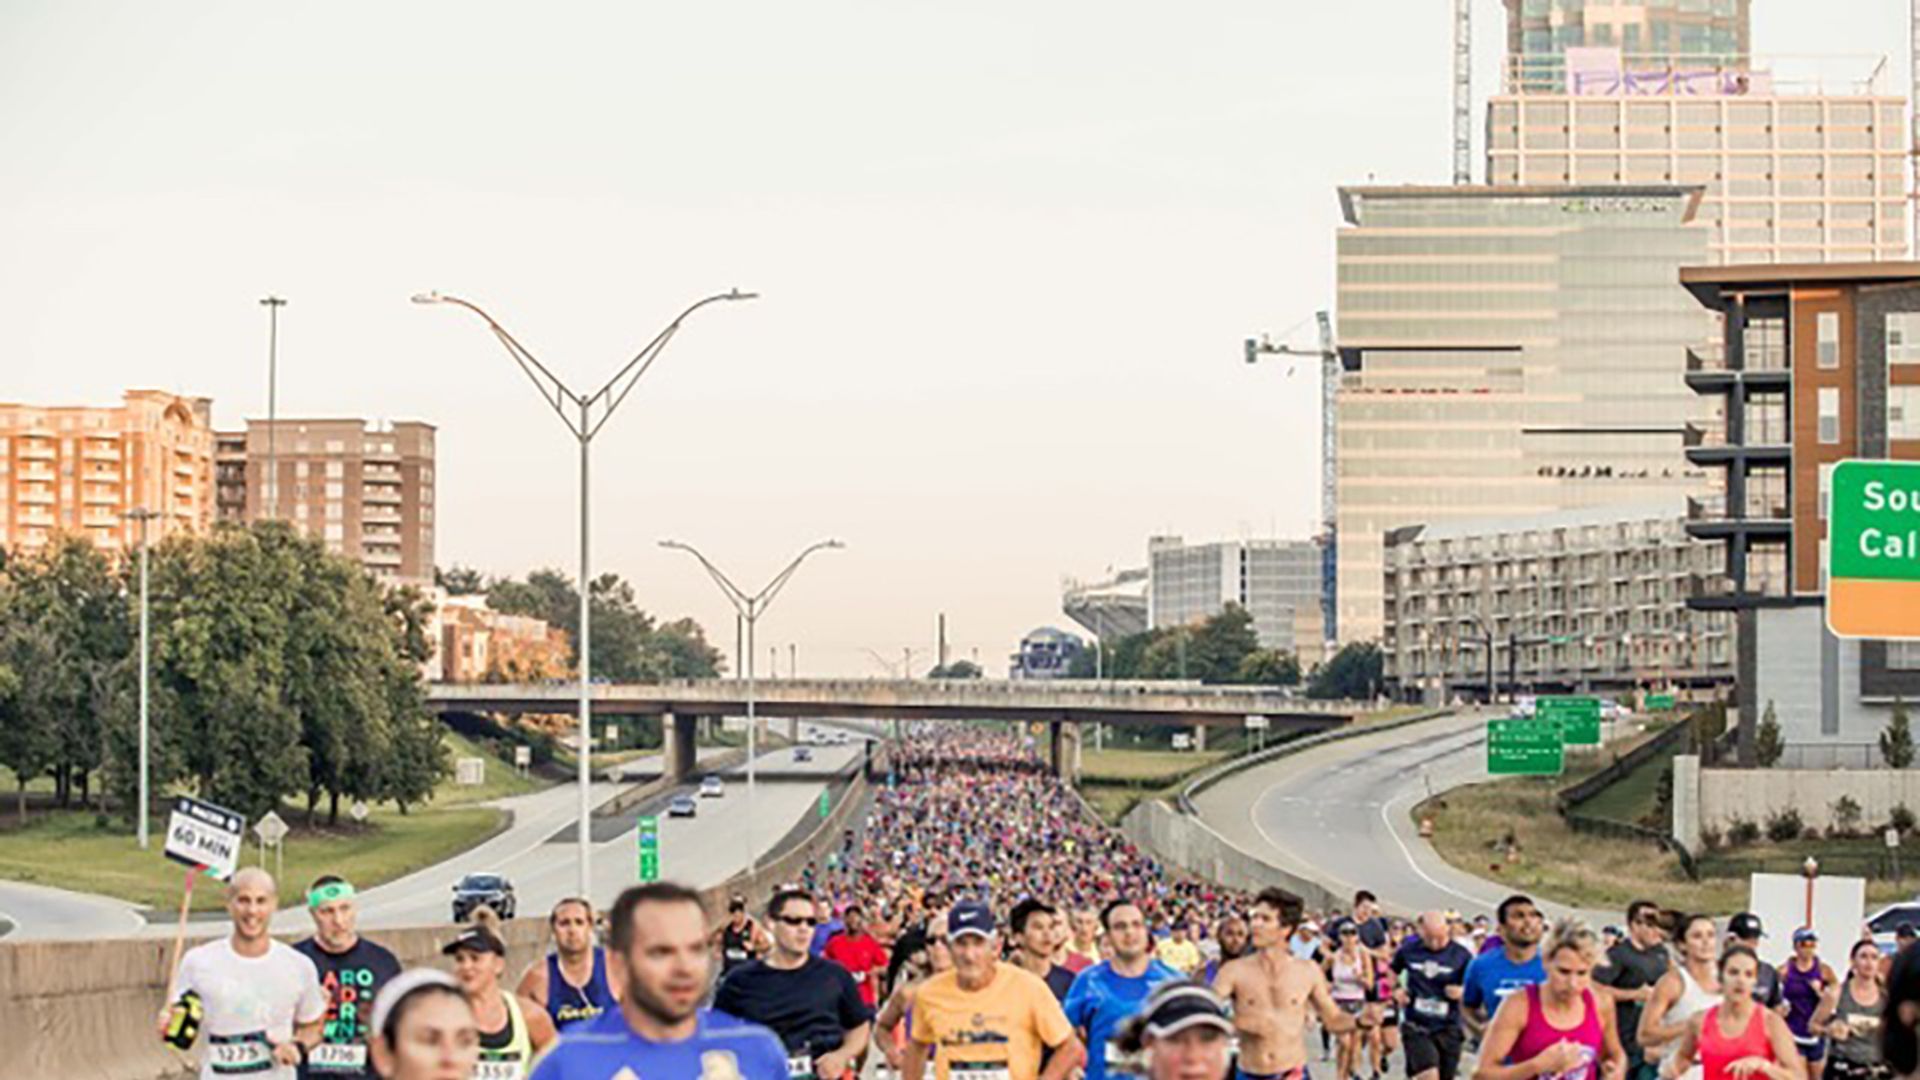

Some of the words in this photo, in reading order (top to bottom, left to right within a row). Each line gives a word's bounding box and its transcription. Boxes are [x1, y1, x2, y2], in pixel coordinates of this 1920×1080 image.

[1862, 481, 1920, 511] Sou
[1859, 528, 1917, 558] Cal
[173, 826, 196, 846] 60
[198, 836, 232, 859] MIN
[217, 1046, 259, 1062] 1275
